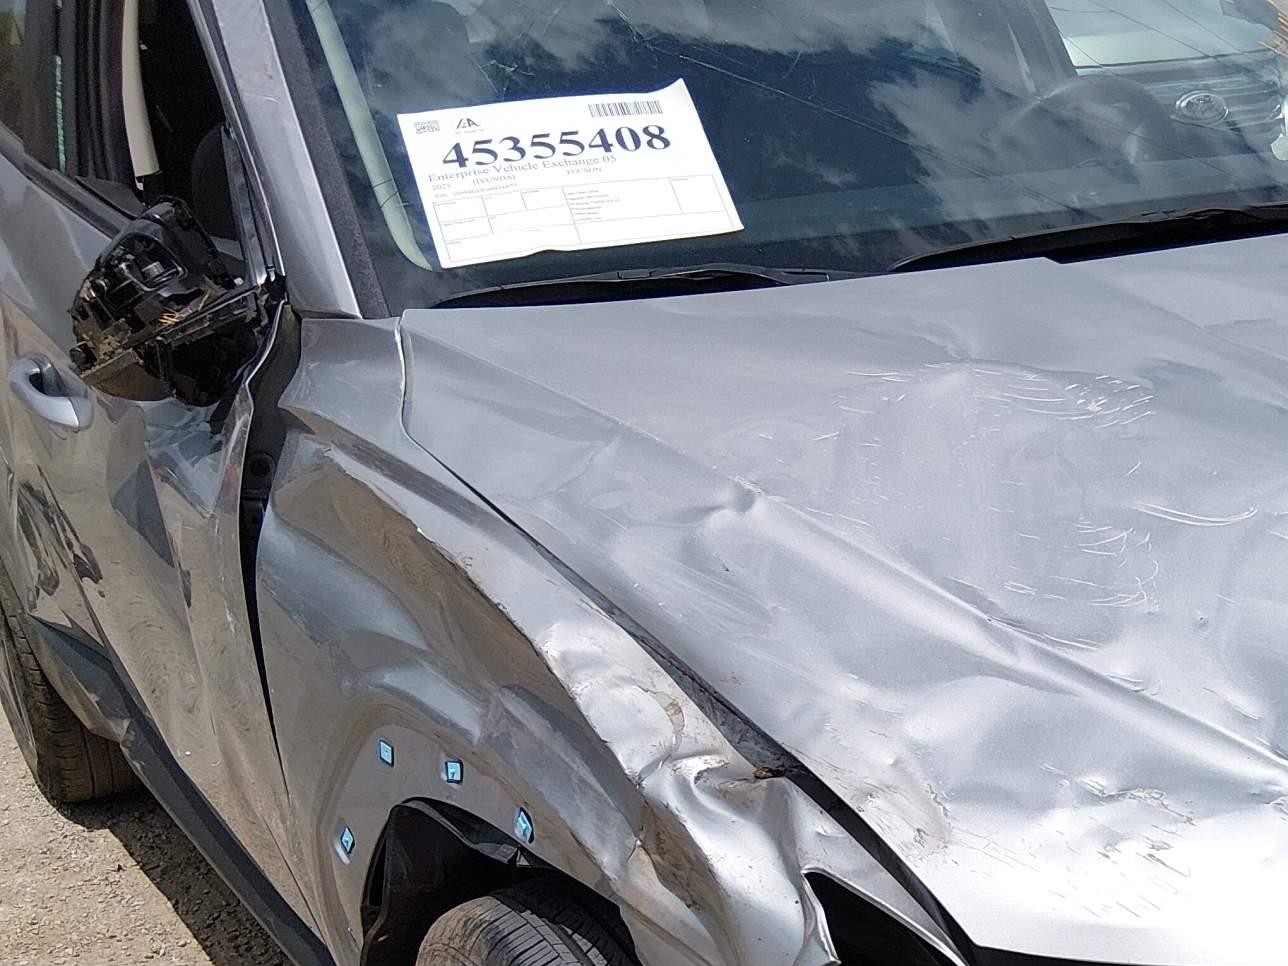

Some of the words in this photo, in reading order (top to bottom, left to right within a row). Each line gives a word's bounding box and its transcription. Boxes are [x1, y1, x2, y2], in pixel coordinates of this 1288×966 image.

[442, 124, 671, 168] 45355408
[428, 168, 489, 182] Enterprise
[493, 162, 539, 173] Vehicle
[542, 157, 600, 169] Exchange
